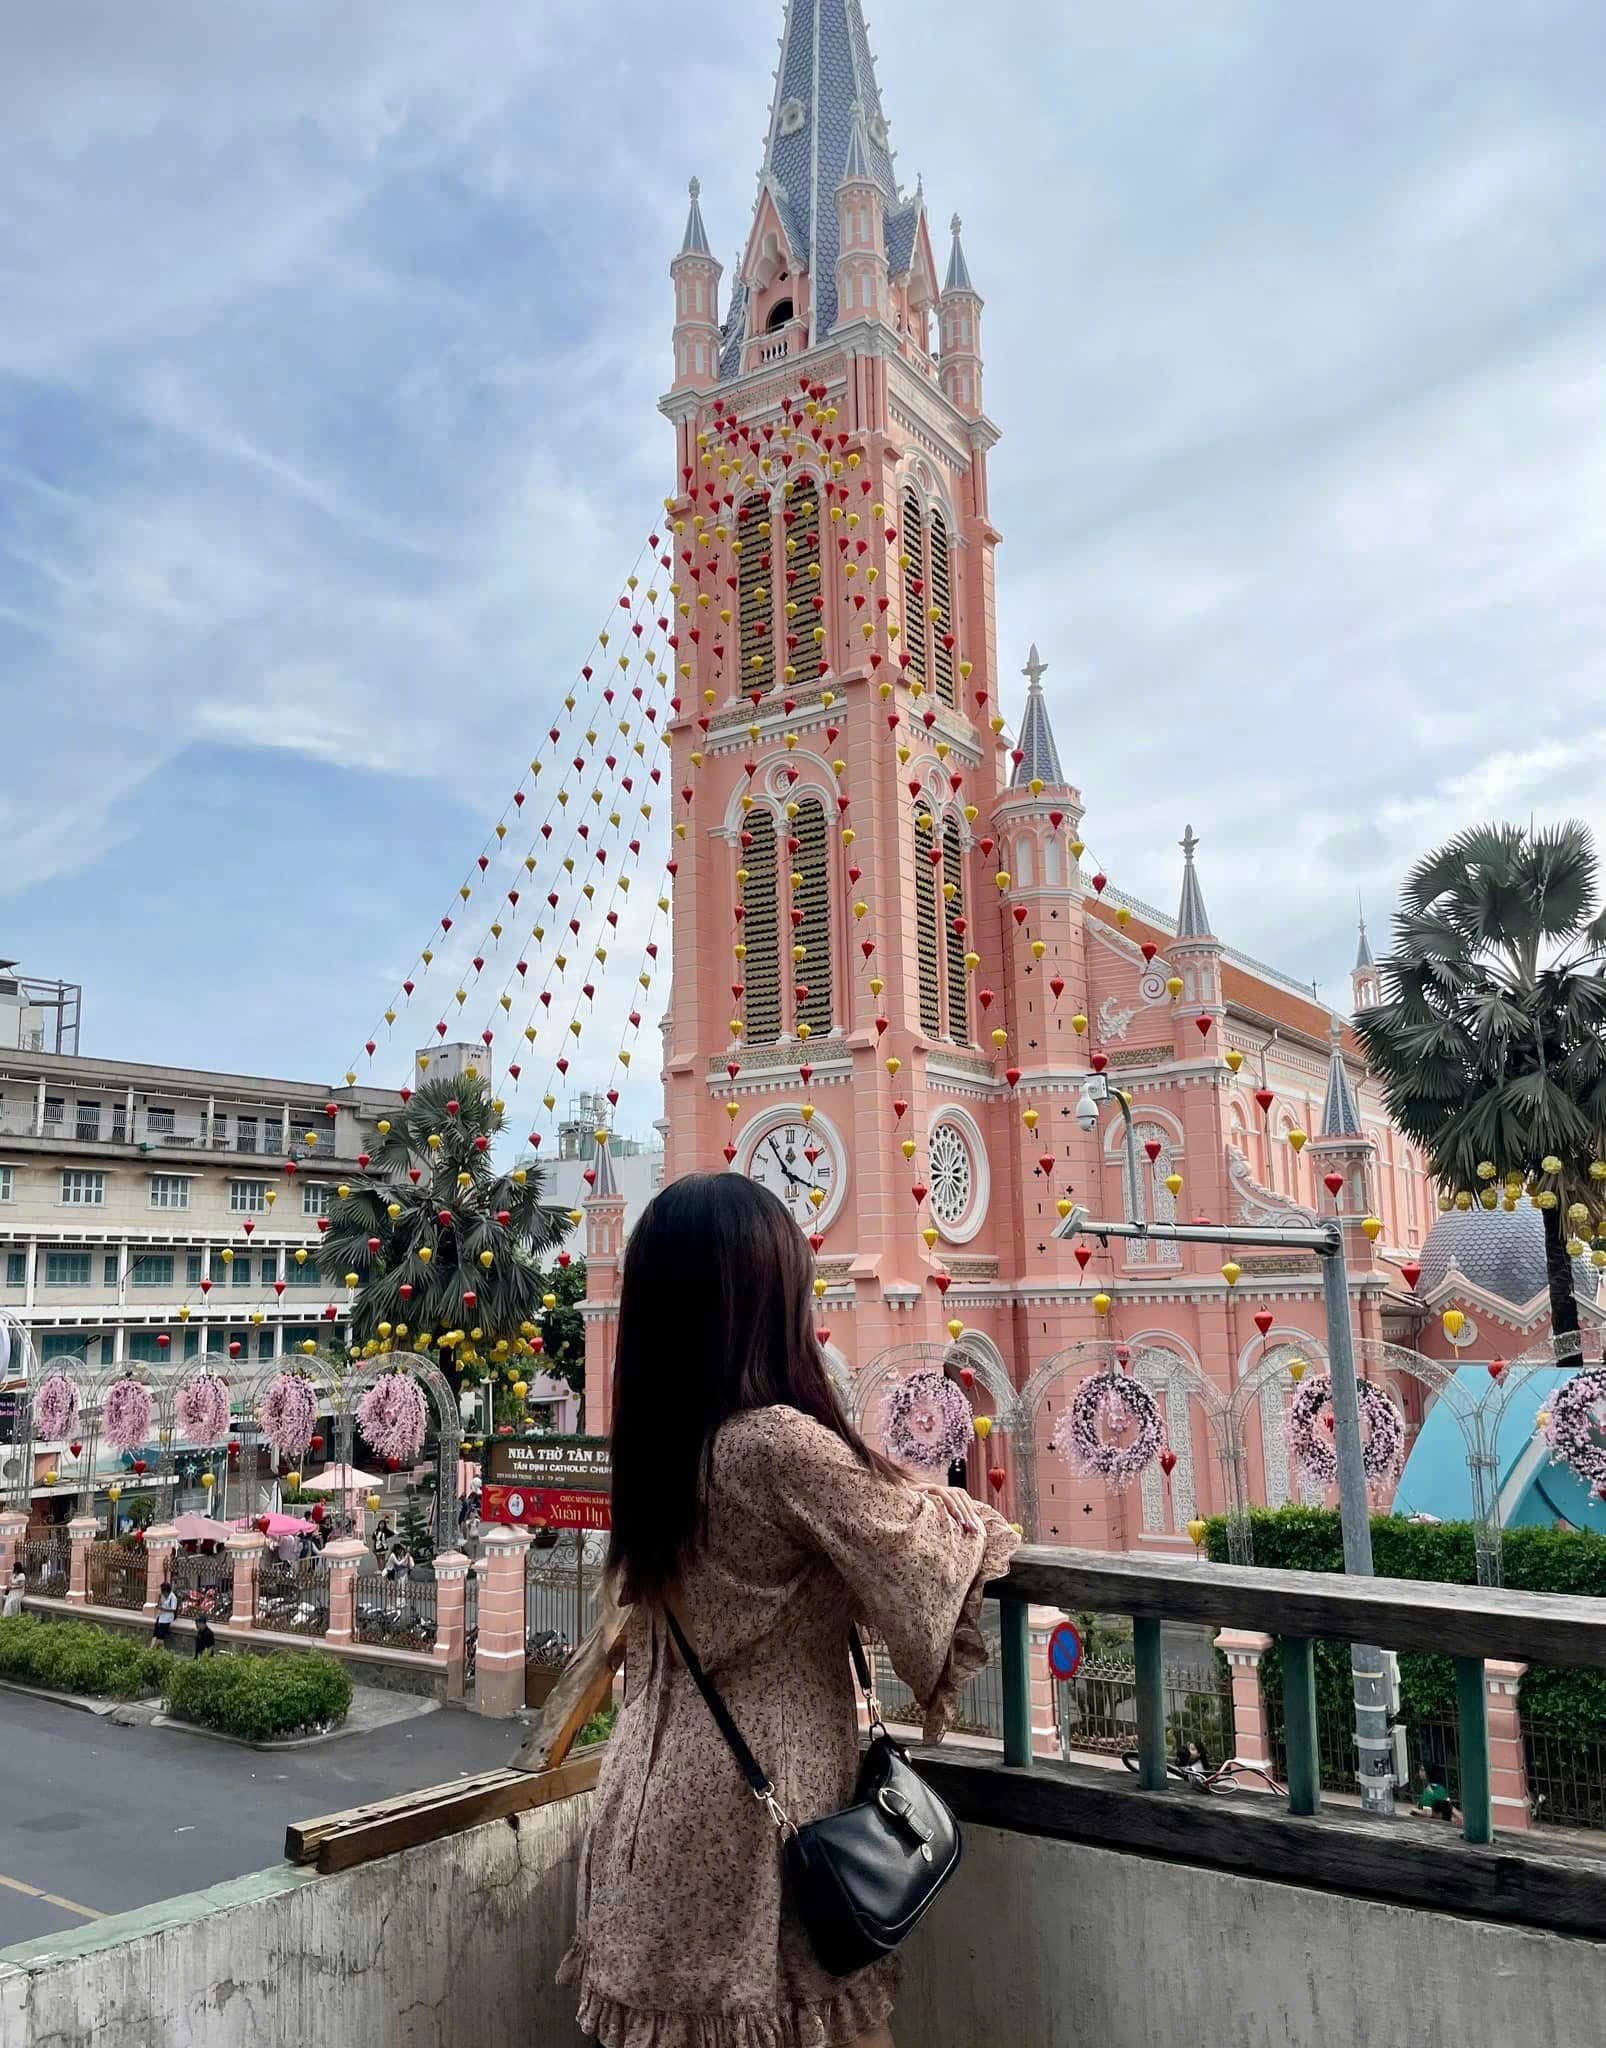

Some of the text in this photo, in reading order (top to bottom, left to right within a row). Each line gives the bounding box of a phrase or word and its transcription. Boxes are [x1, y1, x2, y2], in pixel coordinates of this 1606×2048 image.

[508, 1445, 610, 1465] NHÀ THỜ TÂN ĐỊ
[513, 1461, 528, 1471] TÂN
[549, 1464, 588, 1473] CATHOLIC
[590, 1466, 612, 1474] CHU
[550, 1503, 581, 1521] Xuân
